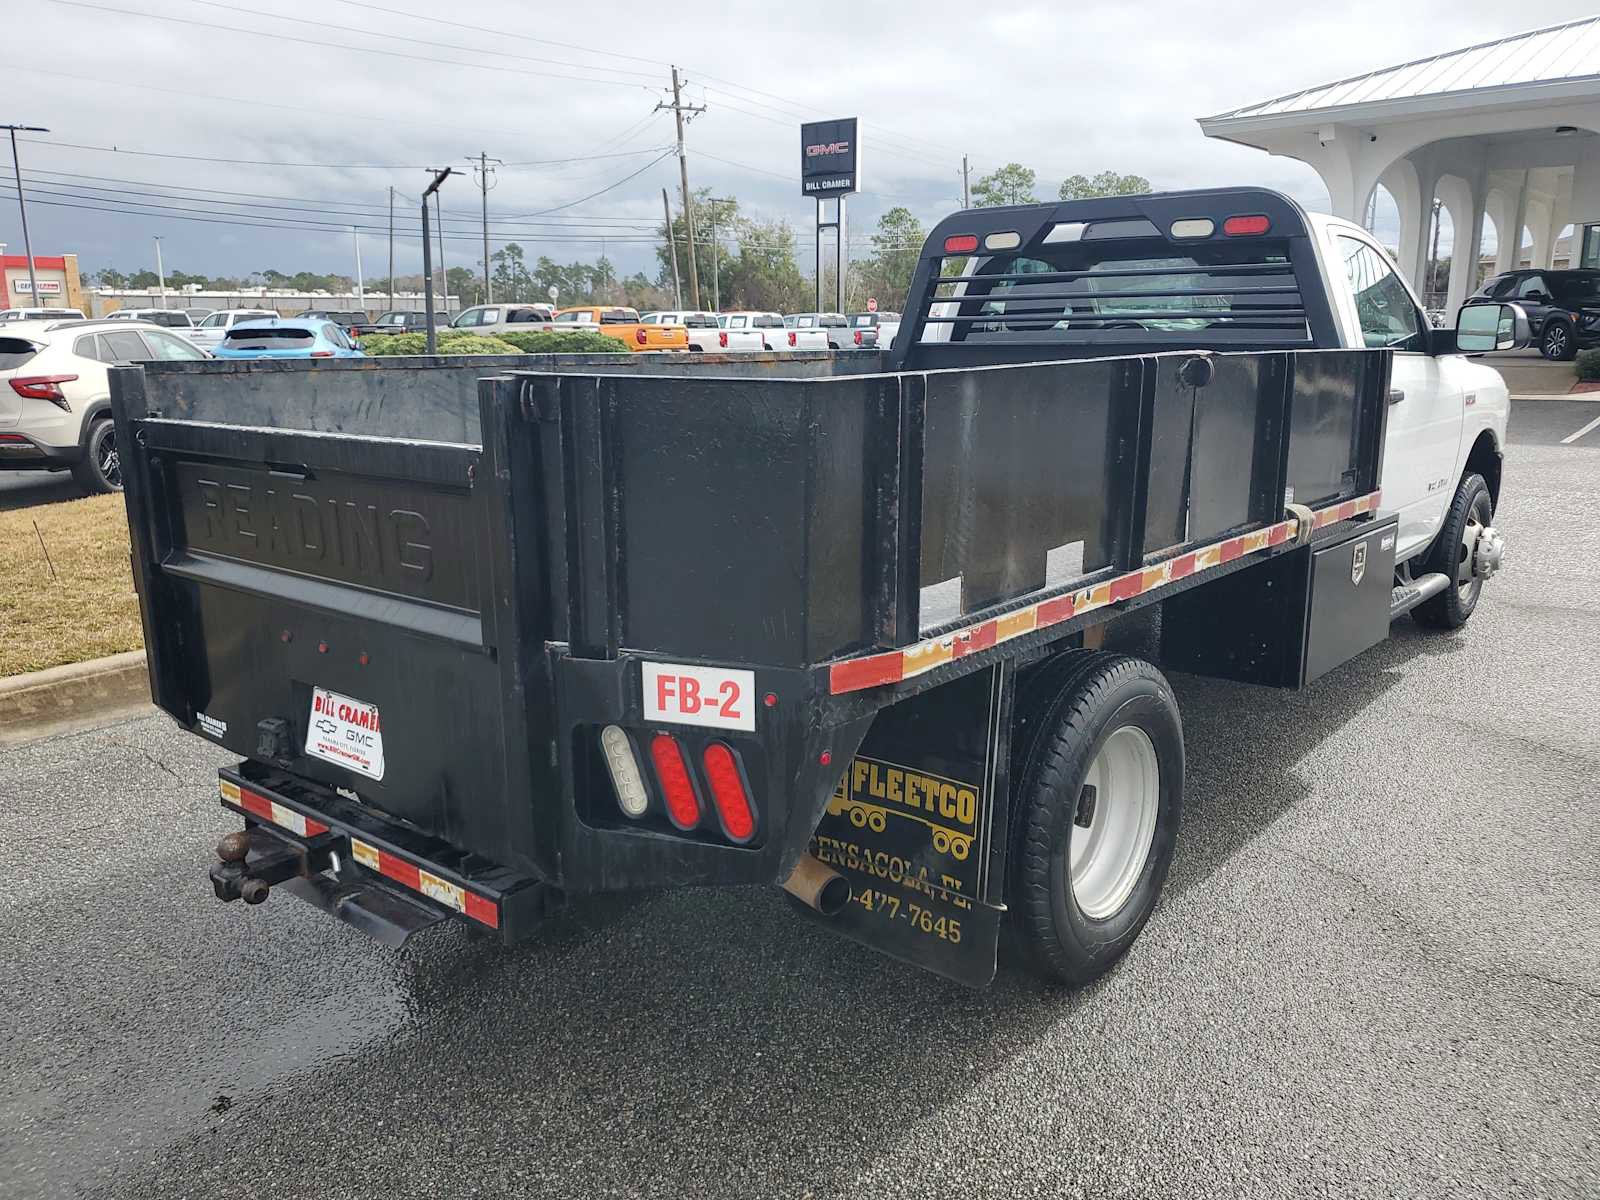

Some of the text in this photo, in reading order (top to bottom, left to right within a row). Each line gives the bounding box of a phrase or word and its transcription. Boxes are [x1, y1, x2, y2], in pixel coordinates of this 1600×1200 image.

[806, 142, 848, 156] GMC
[805, 179, 851, 191] BILL CRAMER
[197, 479, 434, 583] READING
[314, 695, 335, 718] BILL
[656, 674, 741, 719] FB-2
[346, 729, 374, 748] GMC
[853, 761, 976, 825] FLEETCO
[817, 835, 935, 900] ENSACOLA,
